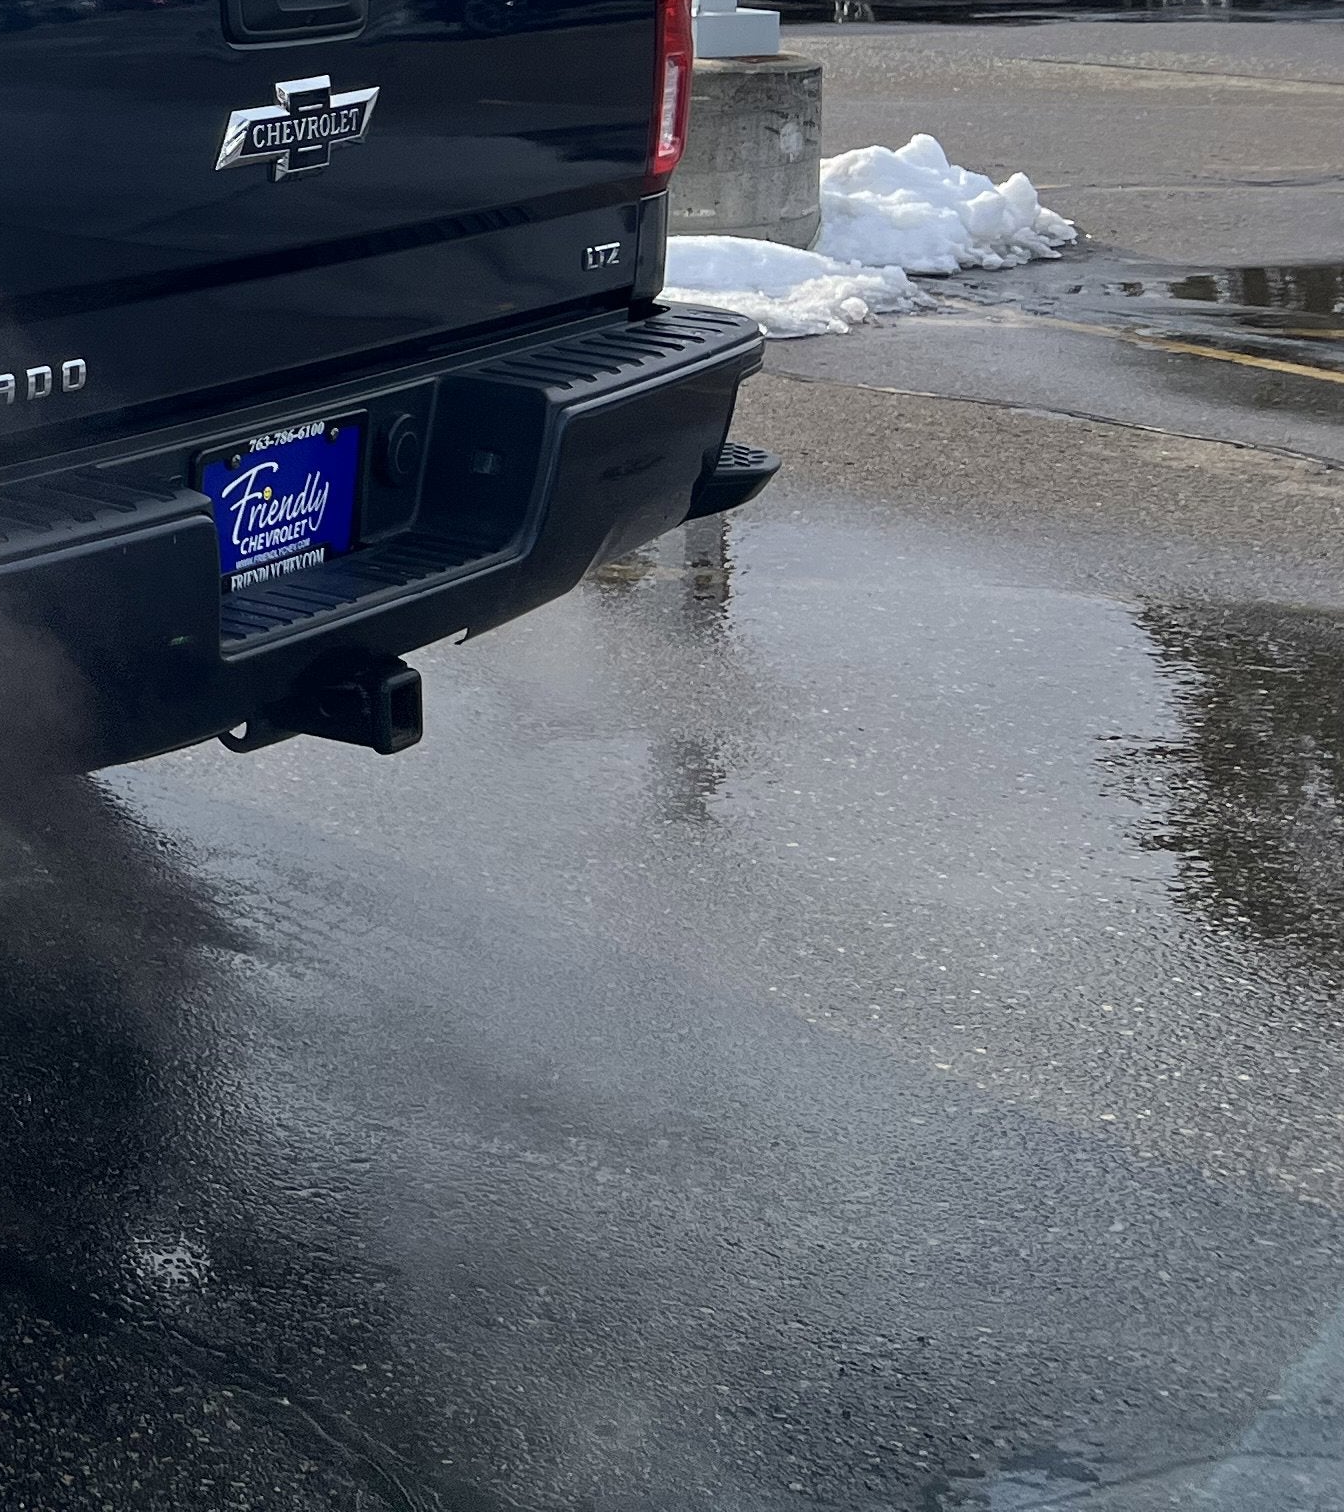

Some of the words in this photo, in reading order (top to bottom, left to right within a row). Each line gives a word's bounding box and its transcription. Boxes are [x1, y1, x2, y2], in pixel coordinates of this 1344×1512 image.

[252, 108, 359, 148] CHEVROLET
[586, 241, 621, 270] LTZ
[249, 421, 325, 453] 763-786-6100
[222, 461, 329, 545] Friendly
[240, 519, 308, 555] CHEVROLET
